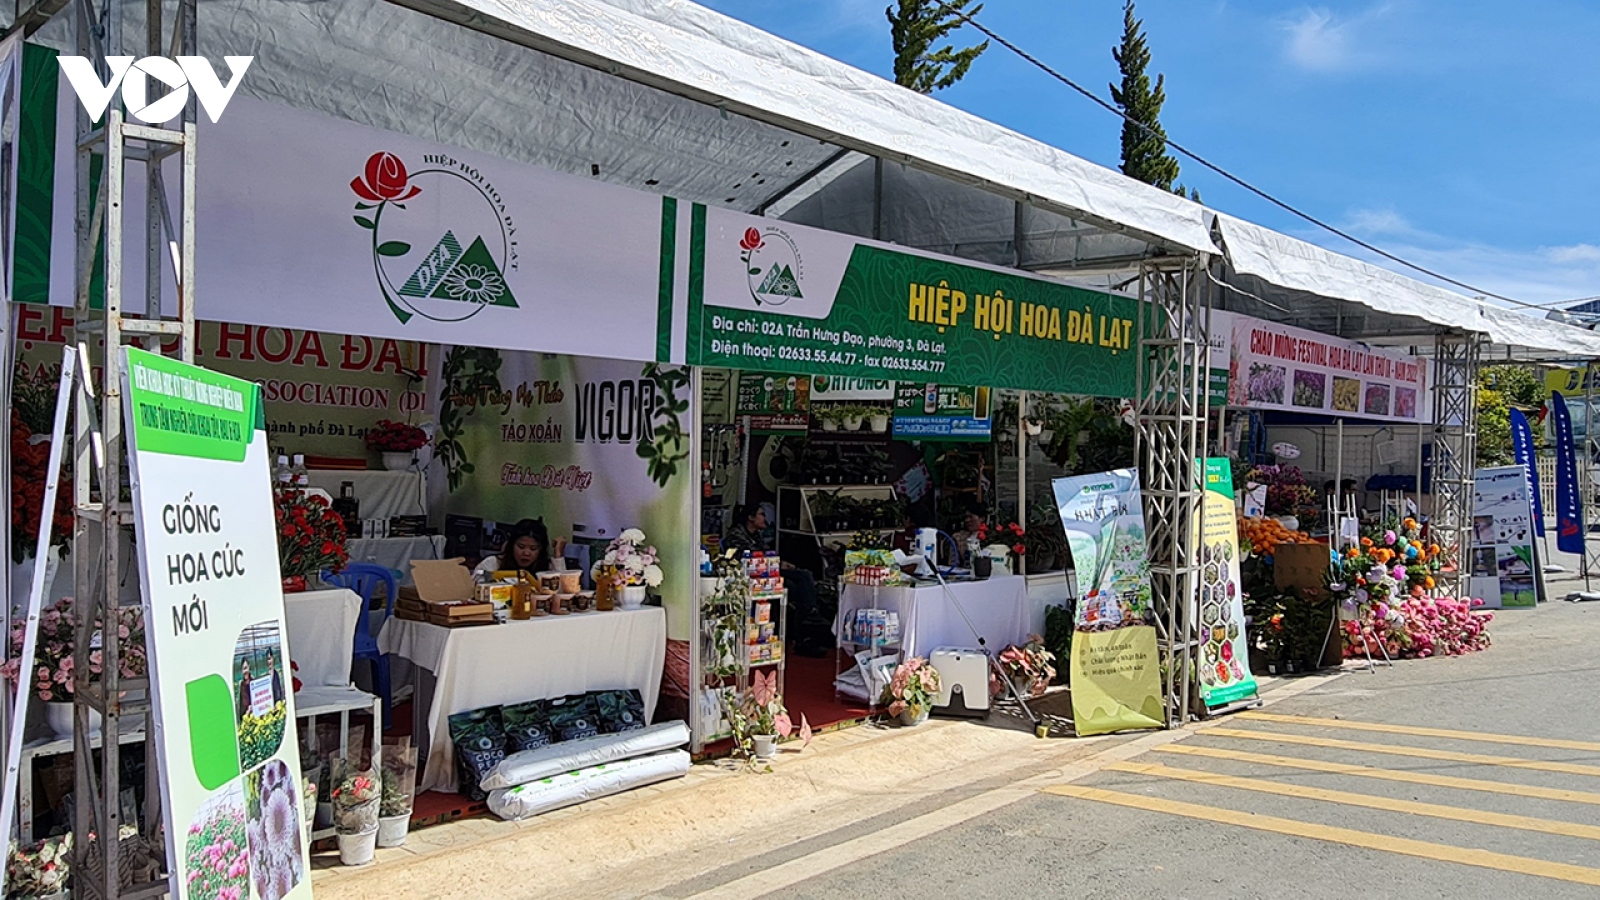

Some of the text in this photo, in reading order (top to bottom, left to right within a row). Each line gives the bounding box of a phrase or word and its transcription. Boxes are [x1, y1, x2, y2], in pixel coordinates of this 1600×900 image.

[424, 154, 457, 167] HIỆP
[460, 163, 484, 183] HỘI
[484, 183, 506, 213] HOA
[417, 244, 451, 290] DFA
[712, 315, 947, 355] Địa chỉ: 02A Trần Hưng Đạo, phường 3, Đà Lạt.
[908, 280, 1133, 355] HIỆP HỘI HOA ĐÀ LẠT
[215, 322, 329, 368] HOA
[711, 339, 740, 358] Điện
[742, 342, 776, 361] thoại:
[778, 345, 857, 365] 02633.55.44.77
[864, 354, 880, 367] fax
[882, 356, 946, 373] 02633.554.777
[1251, 325, 1273, 356] CHÀO
[1274, 330, 1297, 361] MỪNG
[1298, 339, 1327, 366] FESTIVAL
[1329, 346, 1341, 369] HOA
[256, 379, 389, 408] SOCIATION
[534, 380, 565, 404] Thảo
[575, 379, 657, 442] VIGOR
[300, 420, 325, 437] phố
[328, 423, 345, 436] Đà
[501, 416, 562, 442] TẢO XOẮN
[162, 491, 221, 535] GIỐNG
[166, 542, 246, 586] HOA CÚC
[172, 594, 209, 637] MỚI
[475, 749, 505, 763] COCO
